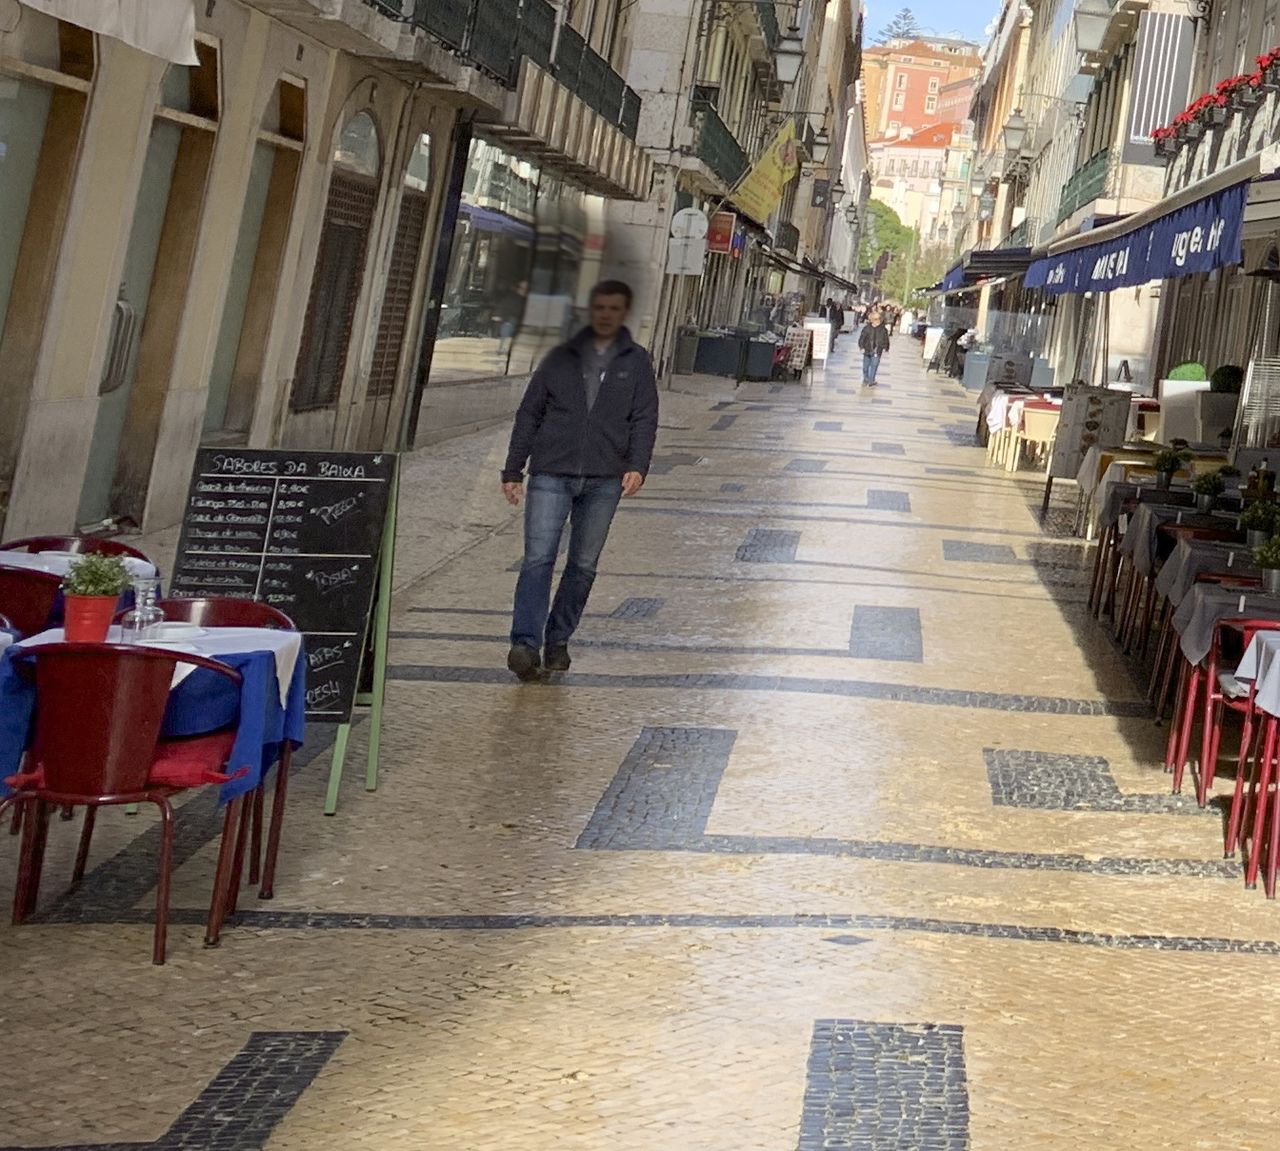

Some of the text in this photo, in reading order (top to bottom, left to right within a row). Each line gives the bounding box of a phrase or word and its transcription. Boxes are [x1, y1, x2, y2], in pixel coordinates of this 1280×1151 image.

[211, 454, 366, 478] SABORES DA BAIXA
